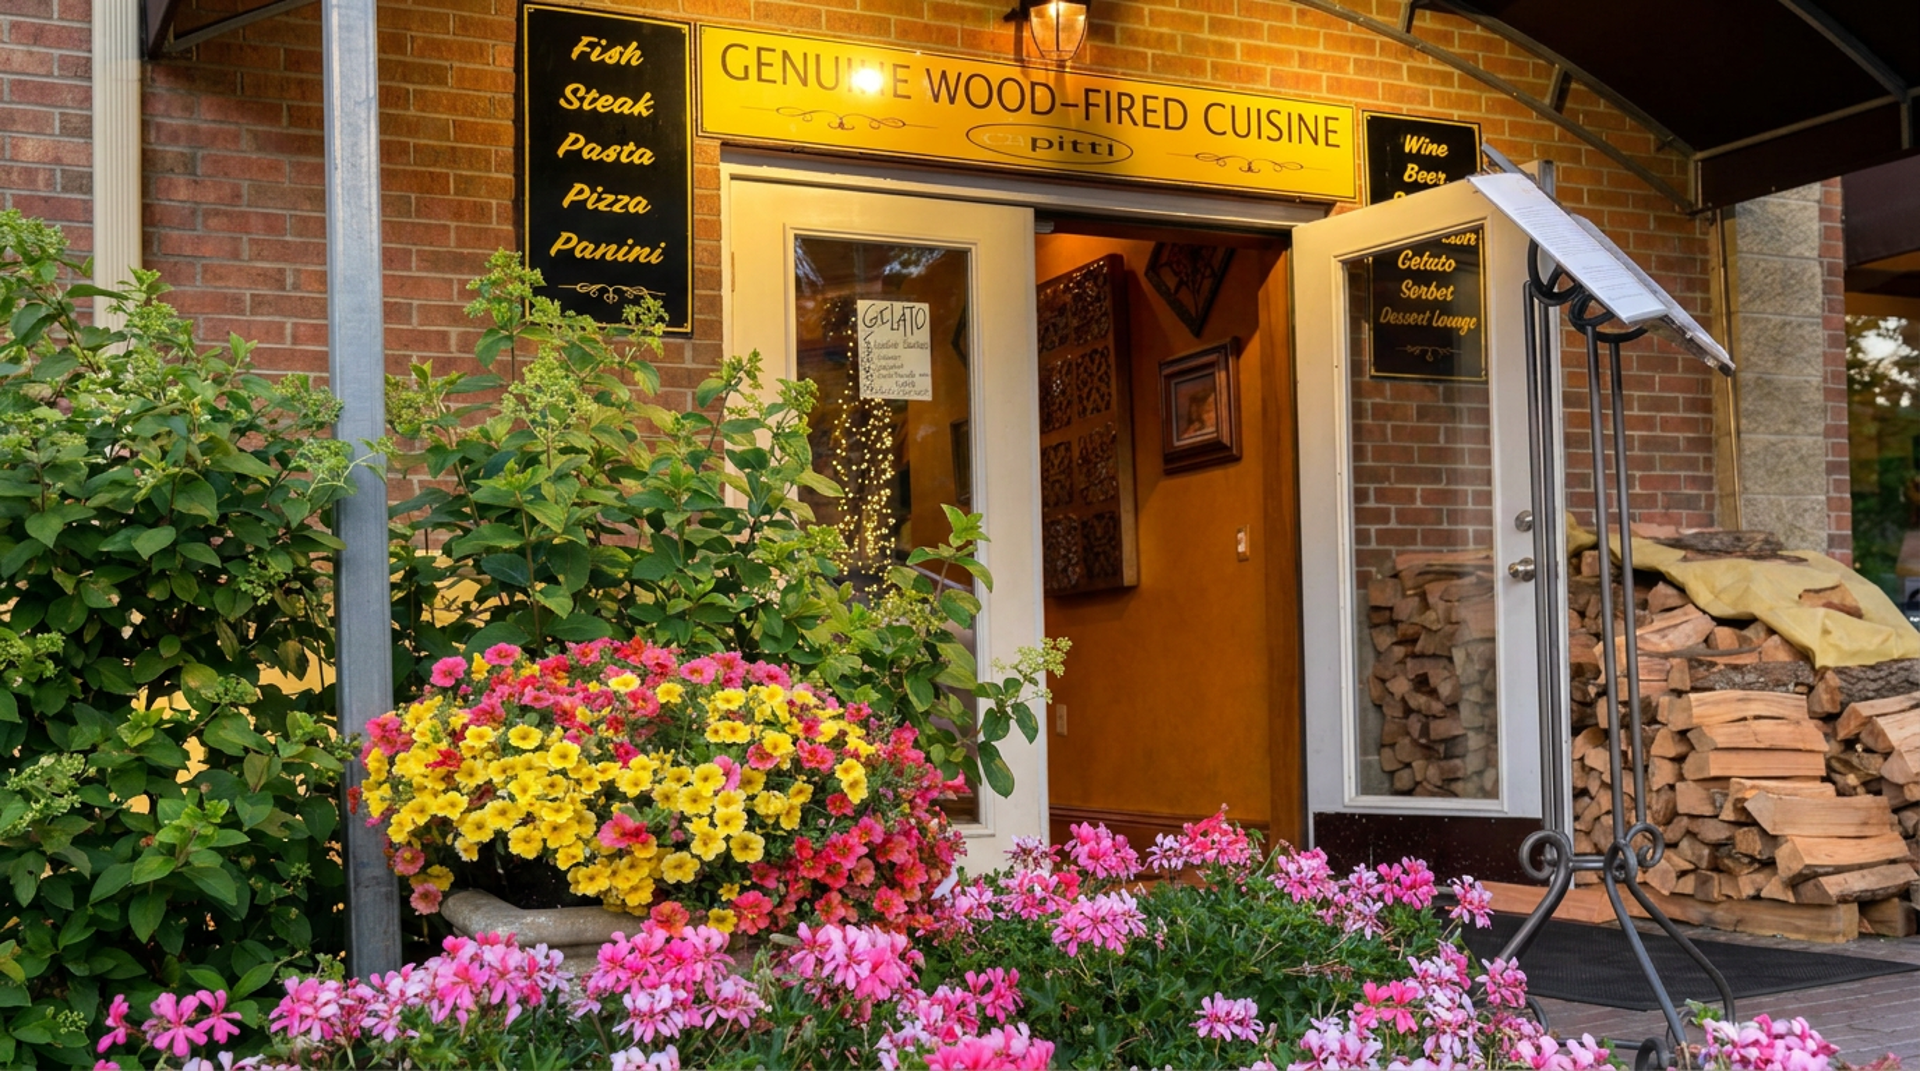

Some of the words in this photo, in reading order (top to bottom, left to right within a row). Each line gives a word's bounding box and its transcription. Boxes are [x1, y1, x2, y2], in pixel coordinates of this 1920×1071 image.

[570, 35, 644, 66] Fish
[558, 82, 655, 118] Steak
[925, 67, 1189, 132] WOOD-FIRED
[1203, 102, 1341, 149] CUISINE
[556, 131, 656, 166] Pasta
[1403, 133, 1449, 157] Wine
[1402, 162, 1447, 185] Beer
[561, 182, 652, 215] Pizza
[549, 230, 667, 265] Panini
[1400, 278, 1455, 302] Sorbet
[862, 303, 927, 338] GELATO
[1379, 306, 1432, 326] Dessert
